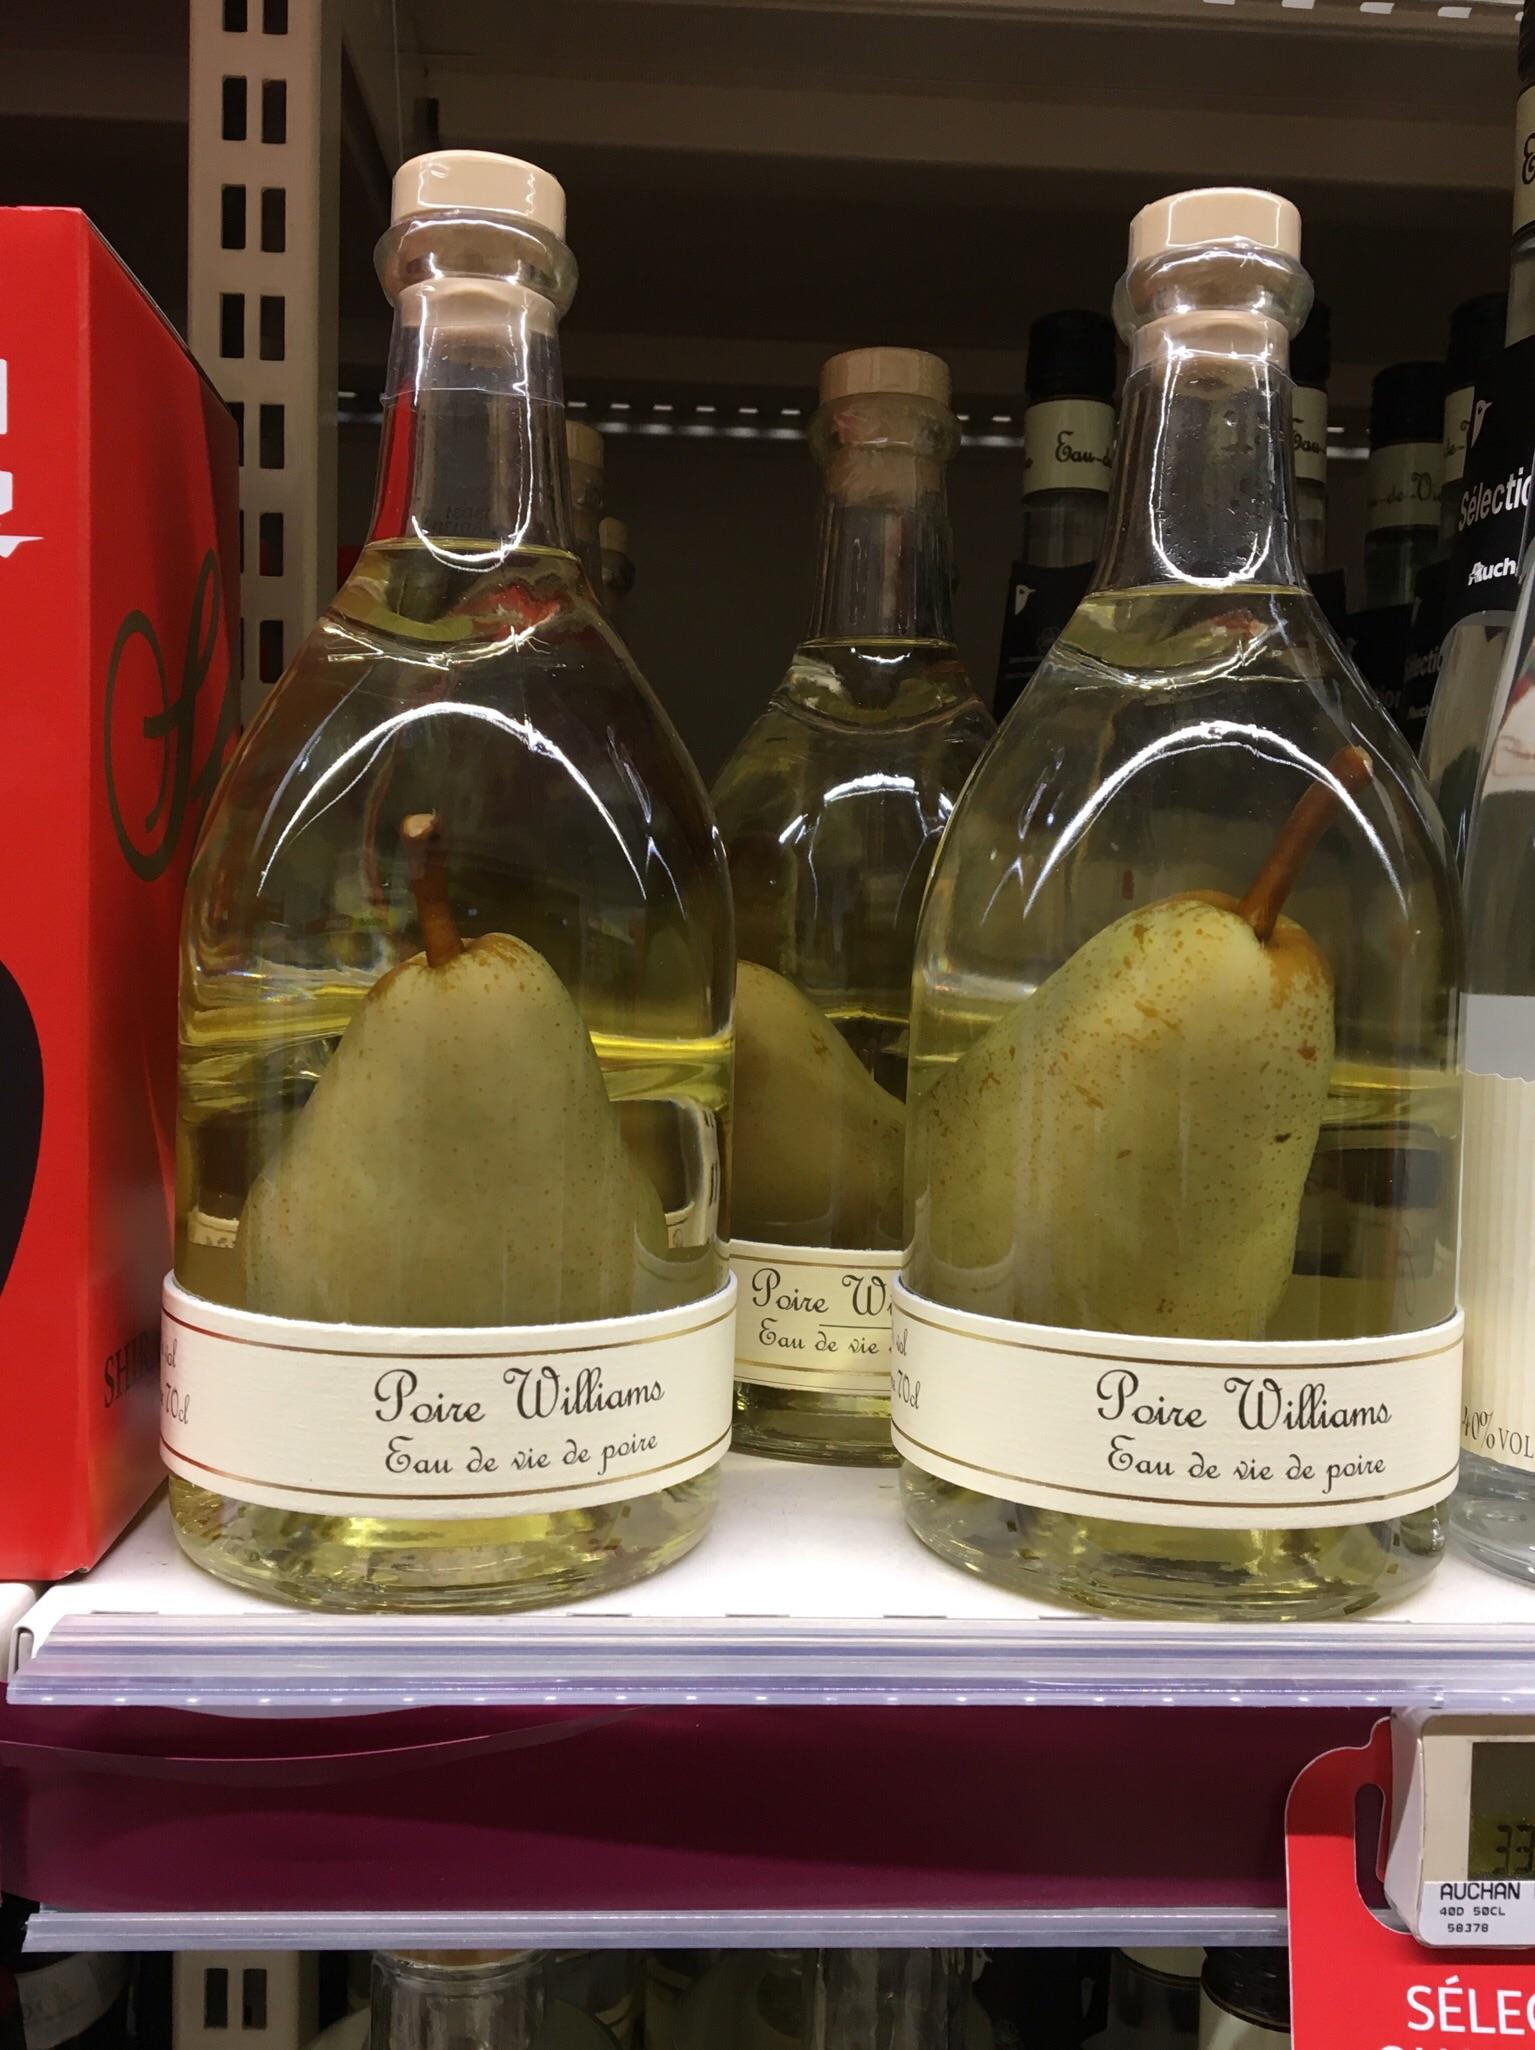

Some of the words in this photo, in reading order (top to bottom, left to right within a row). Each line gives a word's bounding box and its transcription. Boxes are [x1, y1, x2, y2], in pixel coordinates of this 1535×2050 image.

[752, 1268, 829, 1313] Poire
[759, 1318, 805, 1349] Eau
[814, 1331, 838, 1352] de
[849, 1337, 880, 1354] vie
[374, 1368, 485, 1423] Poire
[503, 1366, 665, 1419] Williams
[1096, 1368, 1207, 1428] Poire
[1224, 1377, 1392, 1430] Williams
[385, 1435, 453, 1474] Eau
[466, 1446, 499, 1473] de
[511, 1448, 551, 1470] vie
[562, 1439, 592, 1465] de
[597, 1433, 658, 1475] poire
[1107, 1434, 1175, 1476] Eau
[1188, 1451, 1221, 1479] de
[1233, 1458, 1275, 1480] vie
[1285, 1453, 1316, 1480] de
[1322, 1454, 1386, 1494] poire
[1440, 1882, 1520, 1900] AUCHAN
[1440, 1906, 1464, 1916] 40D
[1473, 1906, 1505, 1916] 50CL
[1447, 1923, 1489, 1933] 58378
